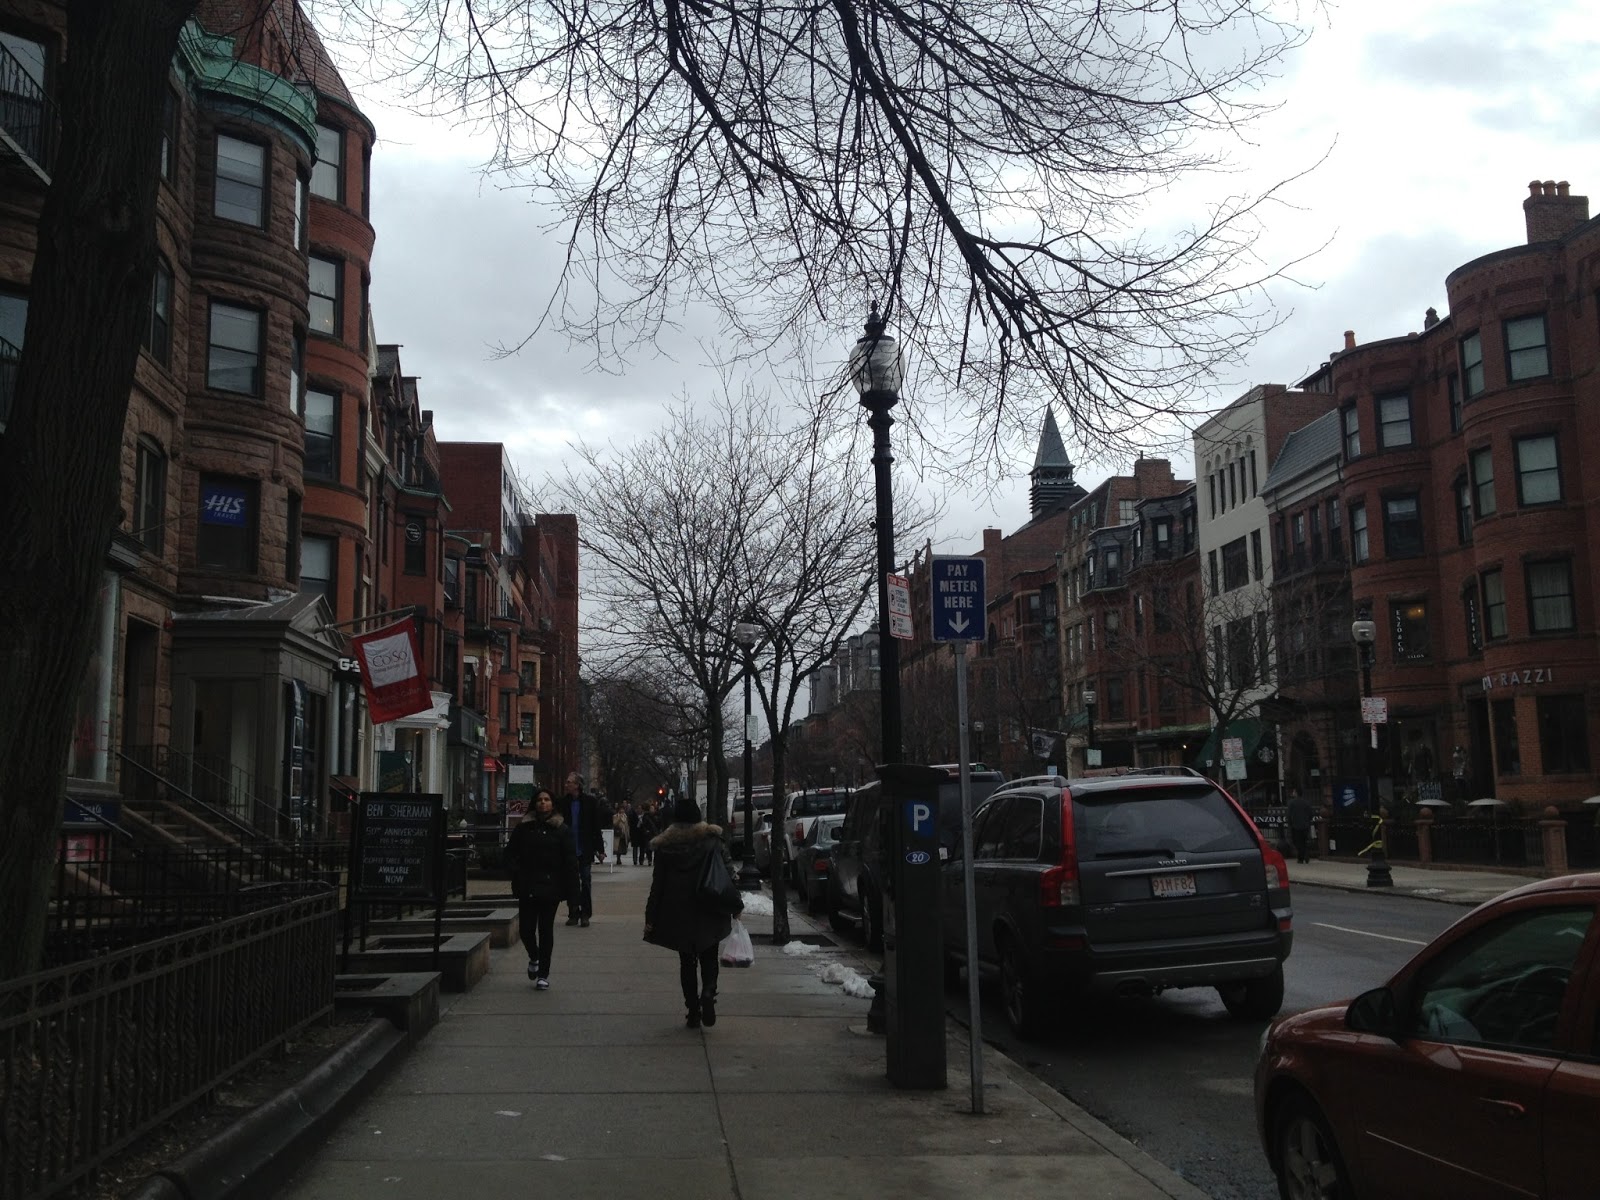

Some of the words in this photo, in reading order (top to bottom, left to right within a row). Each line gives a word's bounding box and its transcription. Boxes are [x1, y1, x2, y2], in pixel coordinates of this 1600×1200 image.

[947, 564, 969, 577] PAY
[939, 580, 978, 593] METER
[944, 596, 973, 609] HERE
[366, 804, 385, 817] BEN
[389, 804, 432, 818] SHERMAN
[913, 804, 930, 832] P
[384, 828, 429, 837] ANNIVERSARY
[912, 853, 924, 863] 20
[1158, 859, 1188, 867] VOLVO
[378, 866, 410, 875] AVAILABLE
[385, 875, 405, 884] NOW
